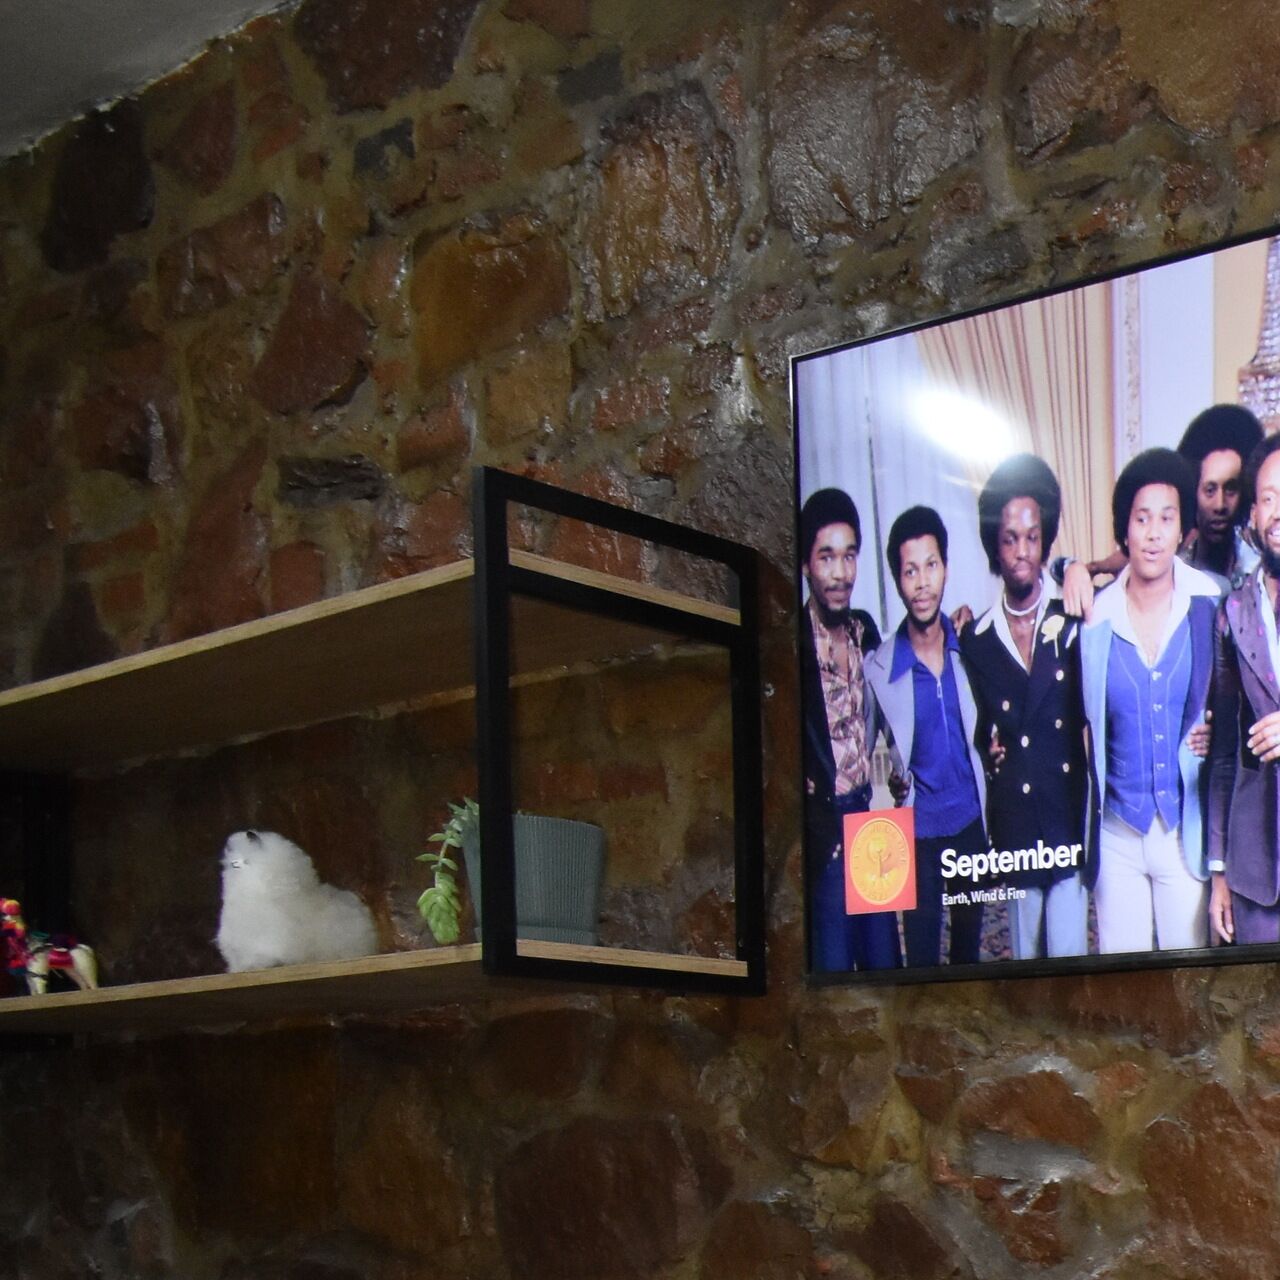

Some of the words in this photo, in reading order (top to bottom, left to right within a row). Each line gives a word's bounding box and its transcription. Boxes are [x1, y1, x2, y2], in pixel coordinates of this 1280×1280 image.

[941, 840, 1082, 882] September
[942, 892, 971, 906] Earth,
[971, 889, 997, 903] Wind
[998, 889, 1006, 900] &
[1007, 887, 1027, 900] Fire
